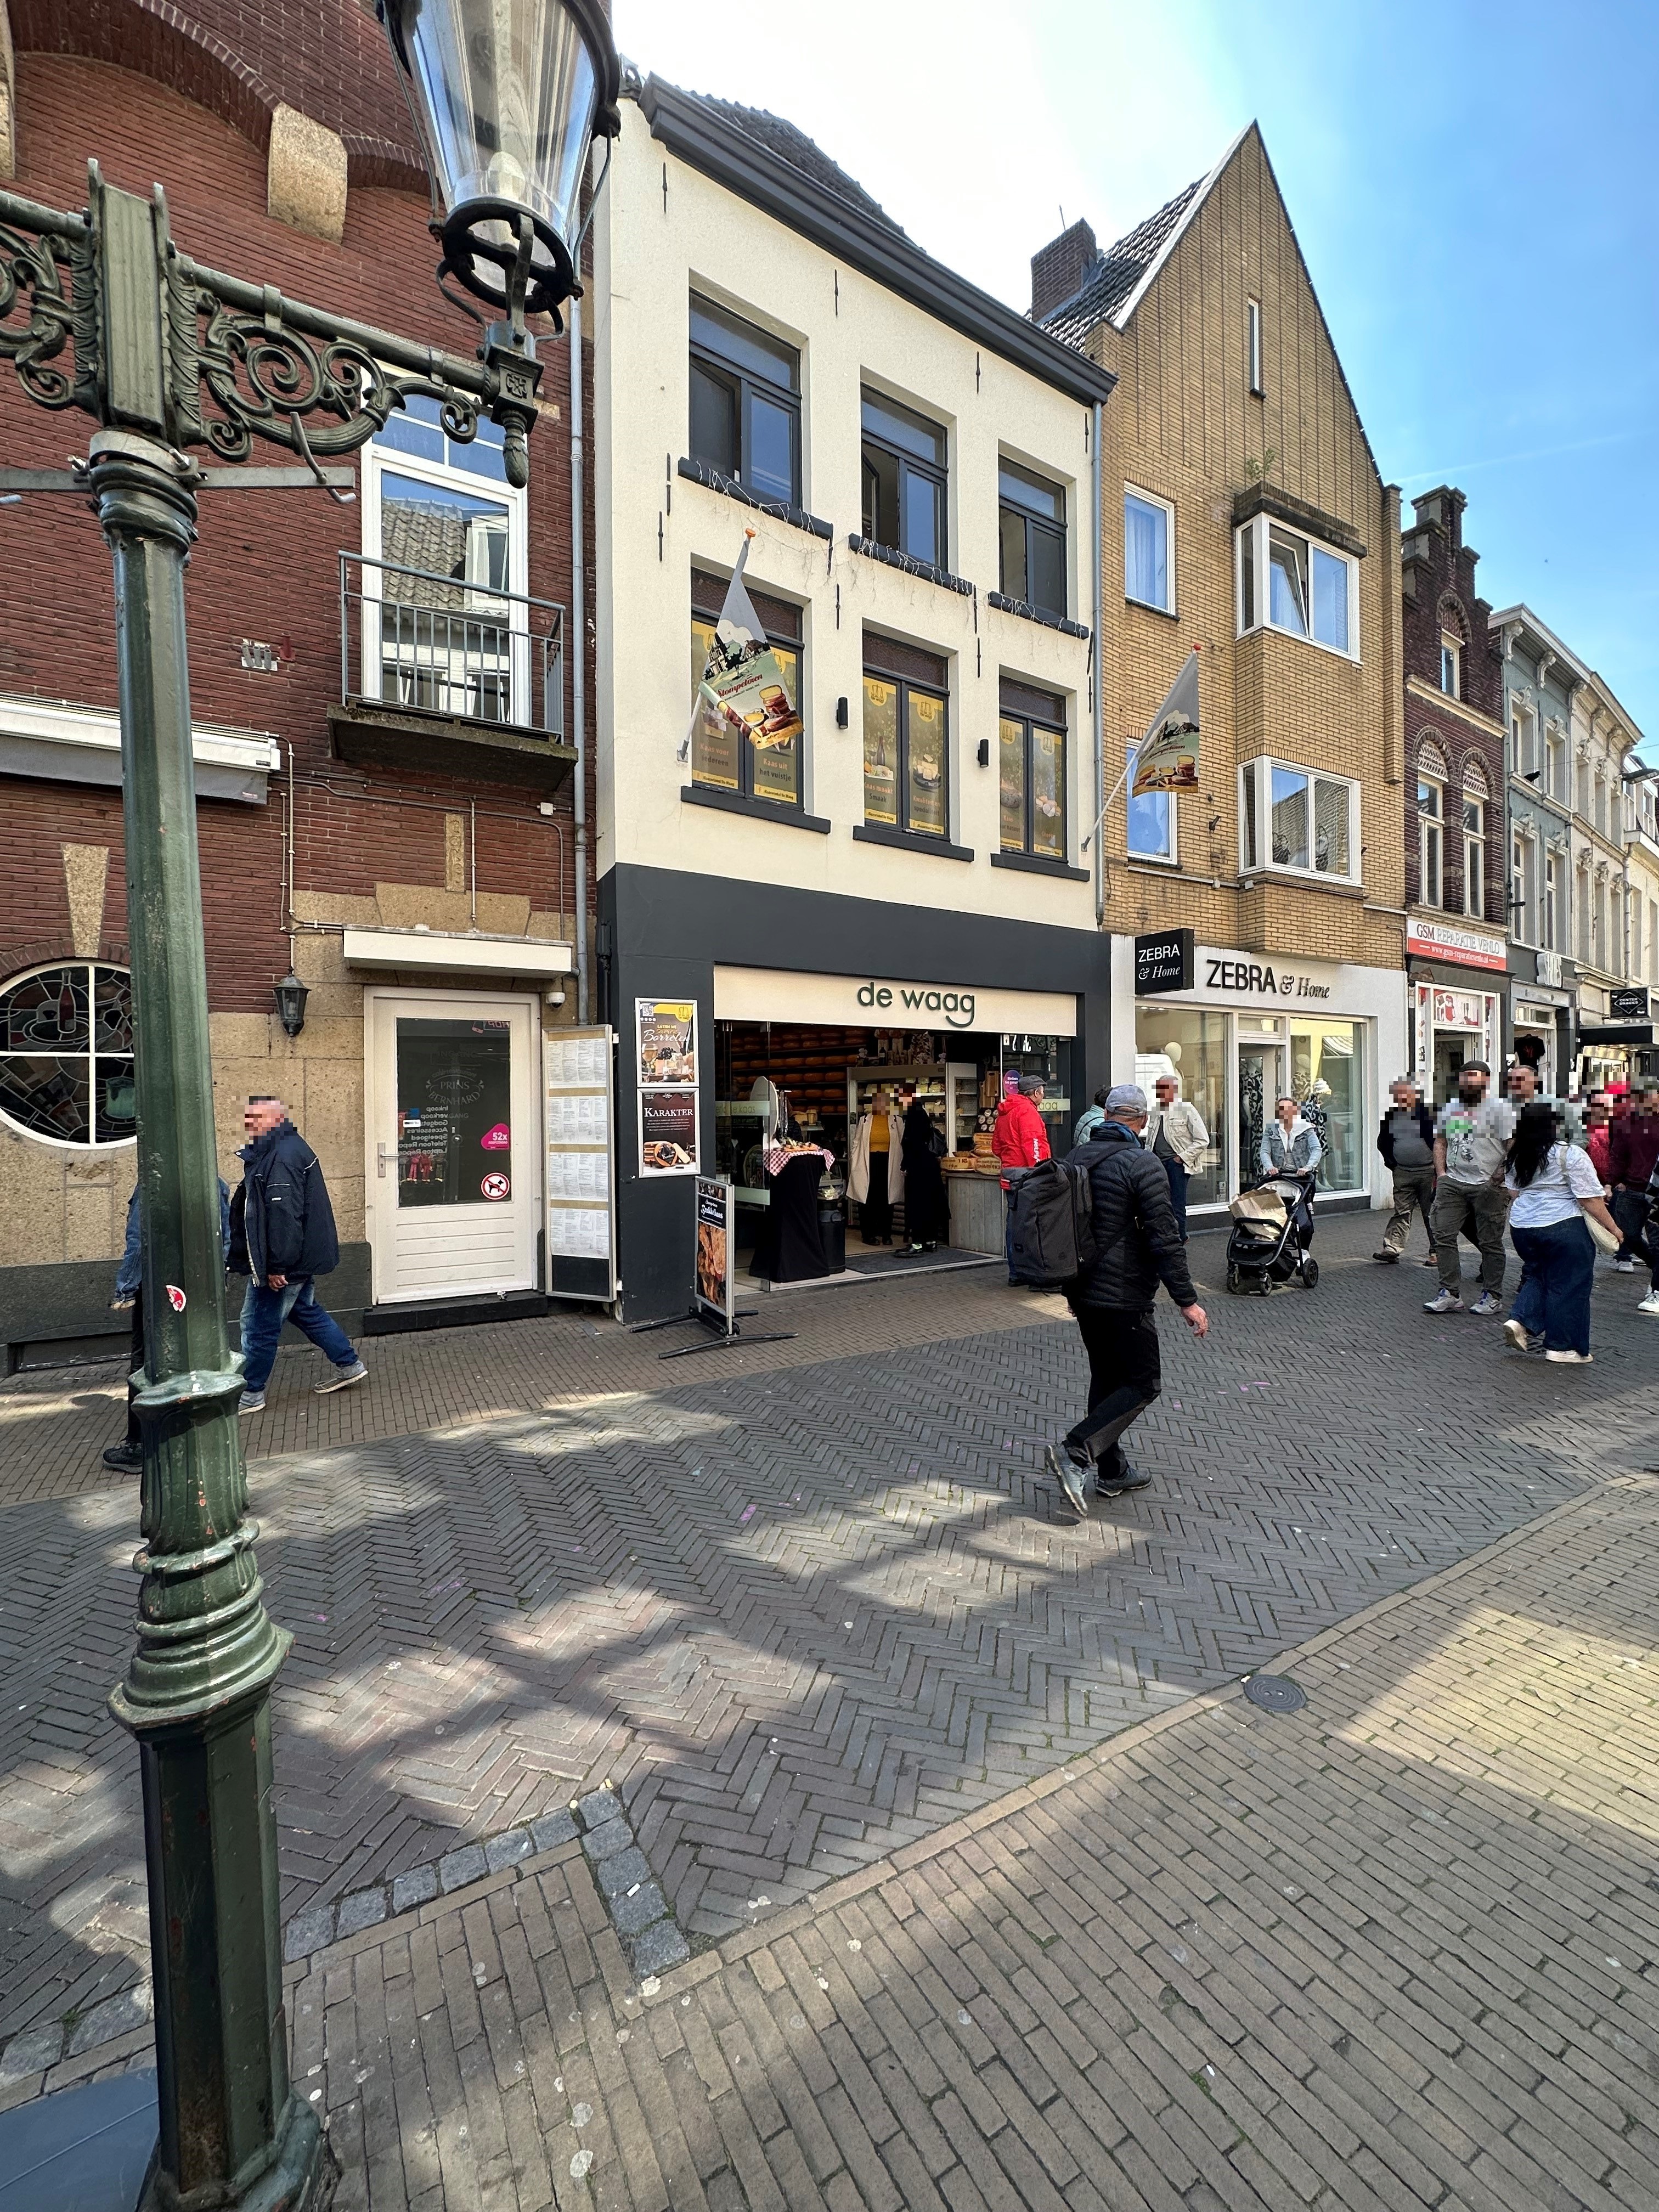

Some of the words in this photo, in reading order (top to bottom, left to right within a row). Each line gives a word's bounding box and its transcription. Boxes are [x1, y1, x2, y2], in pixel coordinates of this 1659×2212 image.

[716, 674, 763, 698] Stompetoren
[699, 742, 714, 753] Kaas
[702, 755, 729, 767] iedereen
[763, 758, 778, 768] Kaas
[759, 768, 770, 777] het
[771, 771, 792, 782] vuistje
[1417, 924, 1435, 940] GSM
[1436, 927, 1476, 950] REPARATIE
[1477, 937, 1500, 955] VENLO
[1138, 944, 1180, 963] ZEBRA
[1138, 967, 1150, 980] &
[1152, 964, 1180, 979] Home
[1206, 959, 1277, 994] ZEBRA
[1280, 975, 1295, 995] &
[1296, 977, 1330, 999] Home
[857, 981, 893, 1008] de
[900, 989, 975, 1029] waag
[440, 1081, 470, 1090] PRINS
[428, 1091, 481, 1106] BERNHARD
[644, 1108, 693, 1118] KARAKTER
[492, 1132, 508, 1141] 52x
